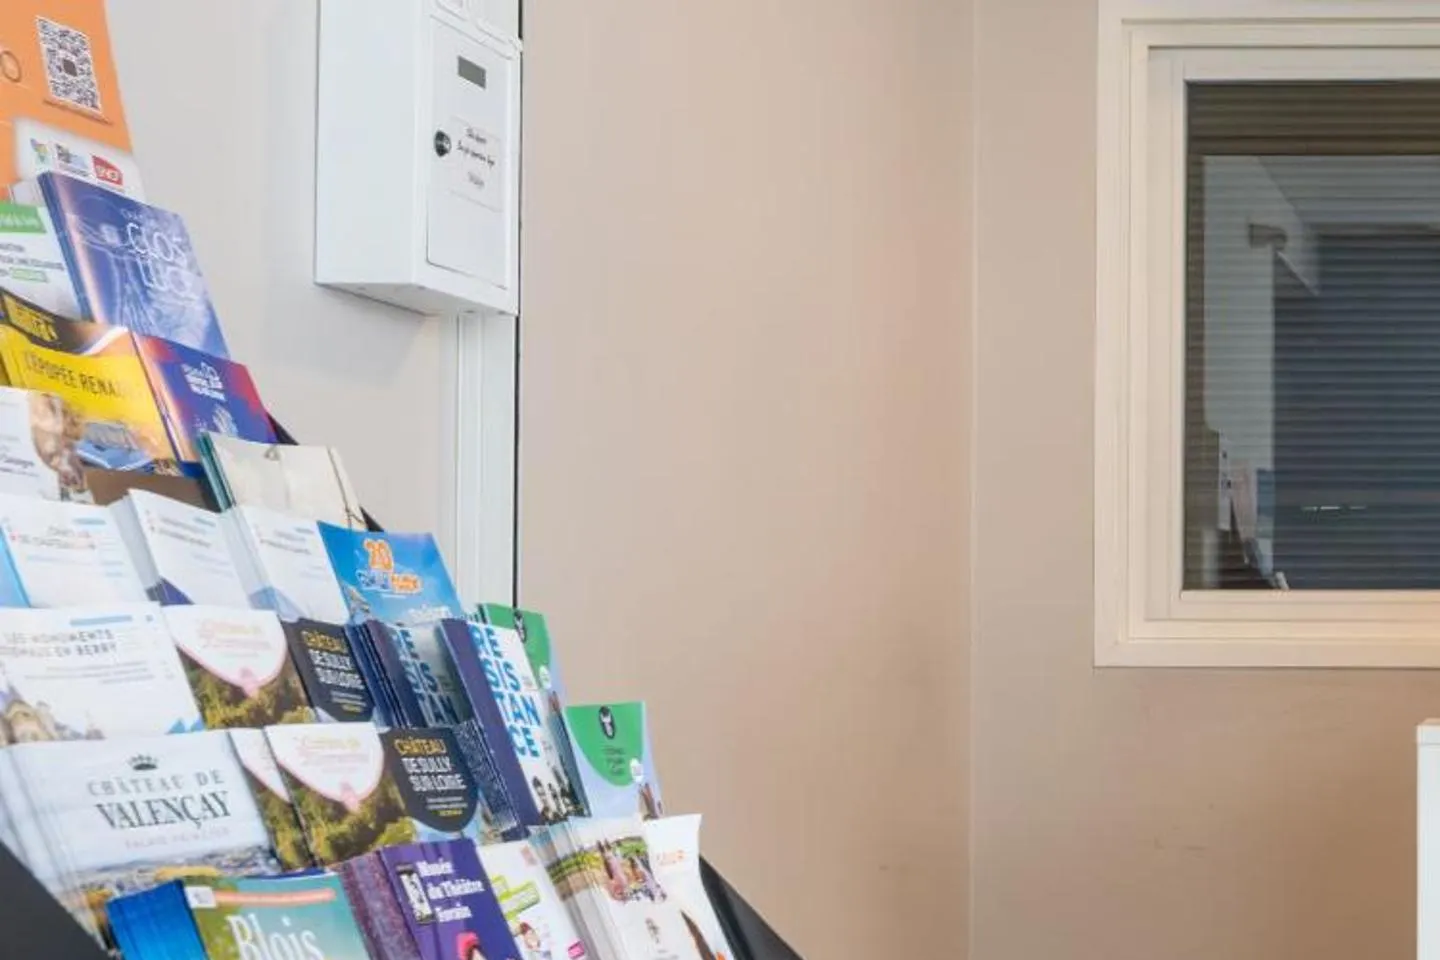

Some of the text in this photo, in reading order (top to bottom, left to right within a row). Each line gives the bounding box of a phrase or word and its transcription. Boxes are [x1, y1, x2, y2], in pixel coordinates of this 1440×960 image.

[394, 736, 446, 756] CHÂTEAU
[87, 769, 225, 797] CHÂTEAU DE
[96, 789, 232, 829] VALENÇAY
